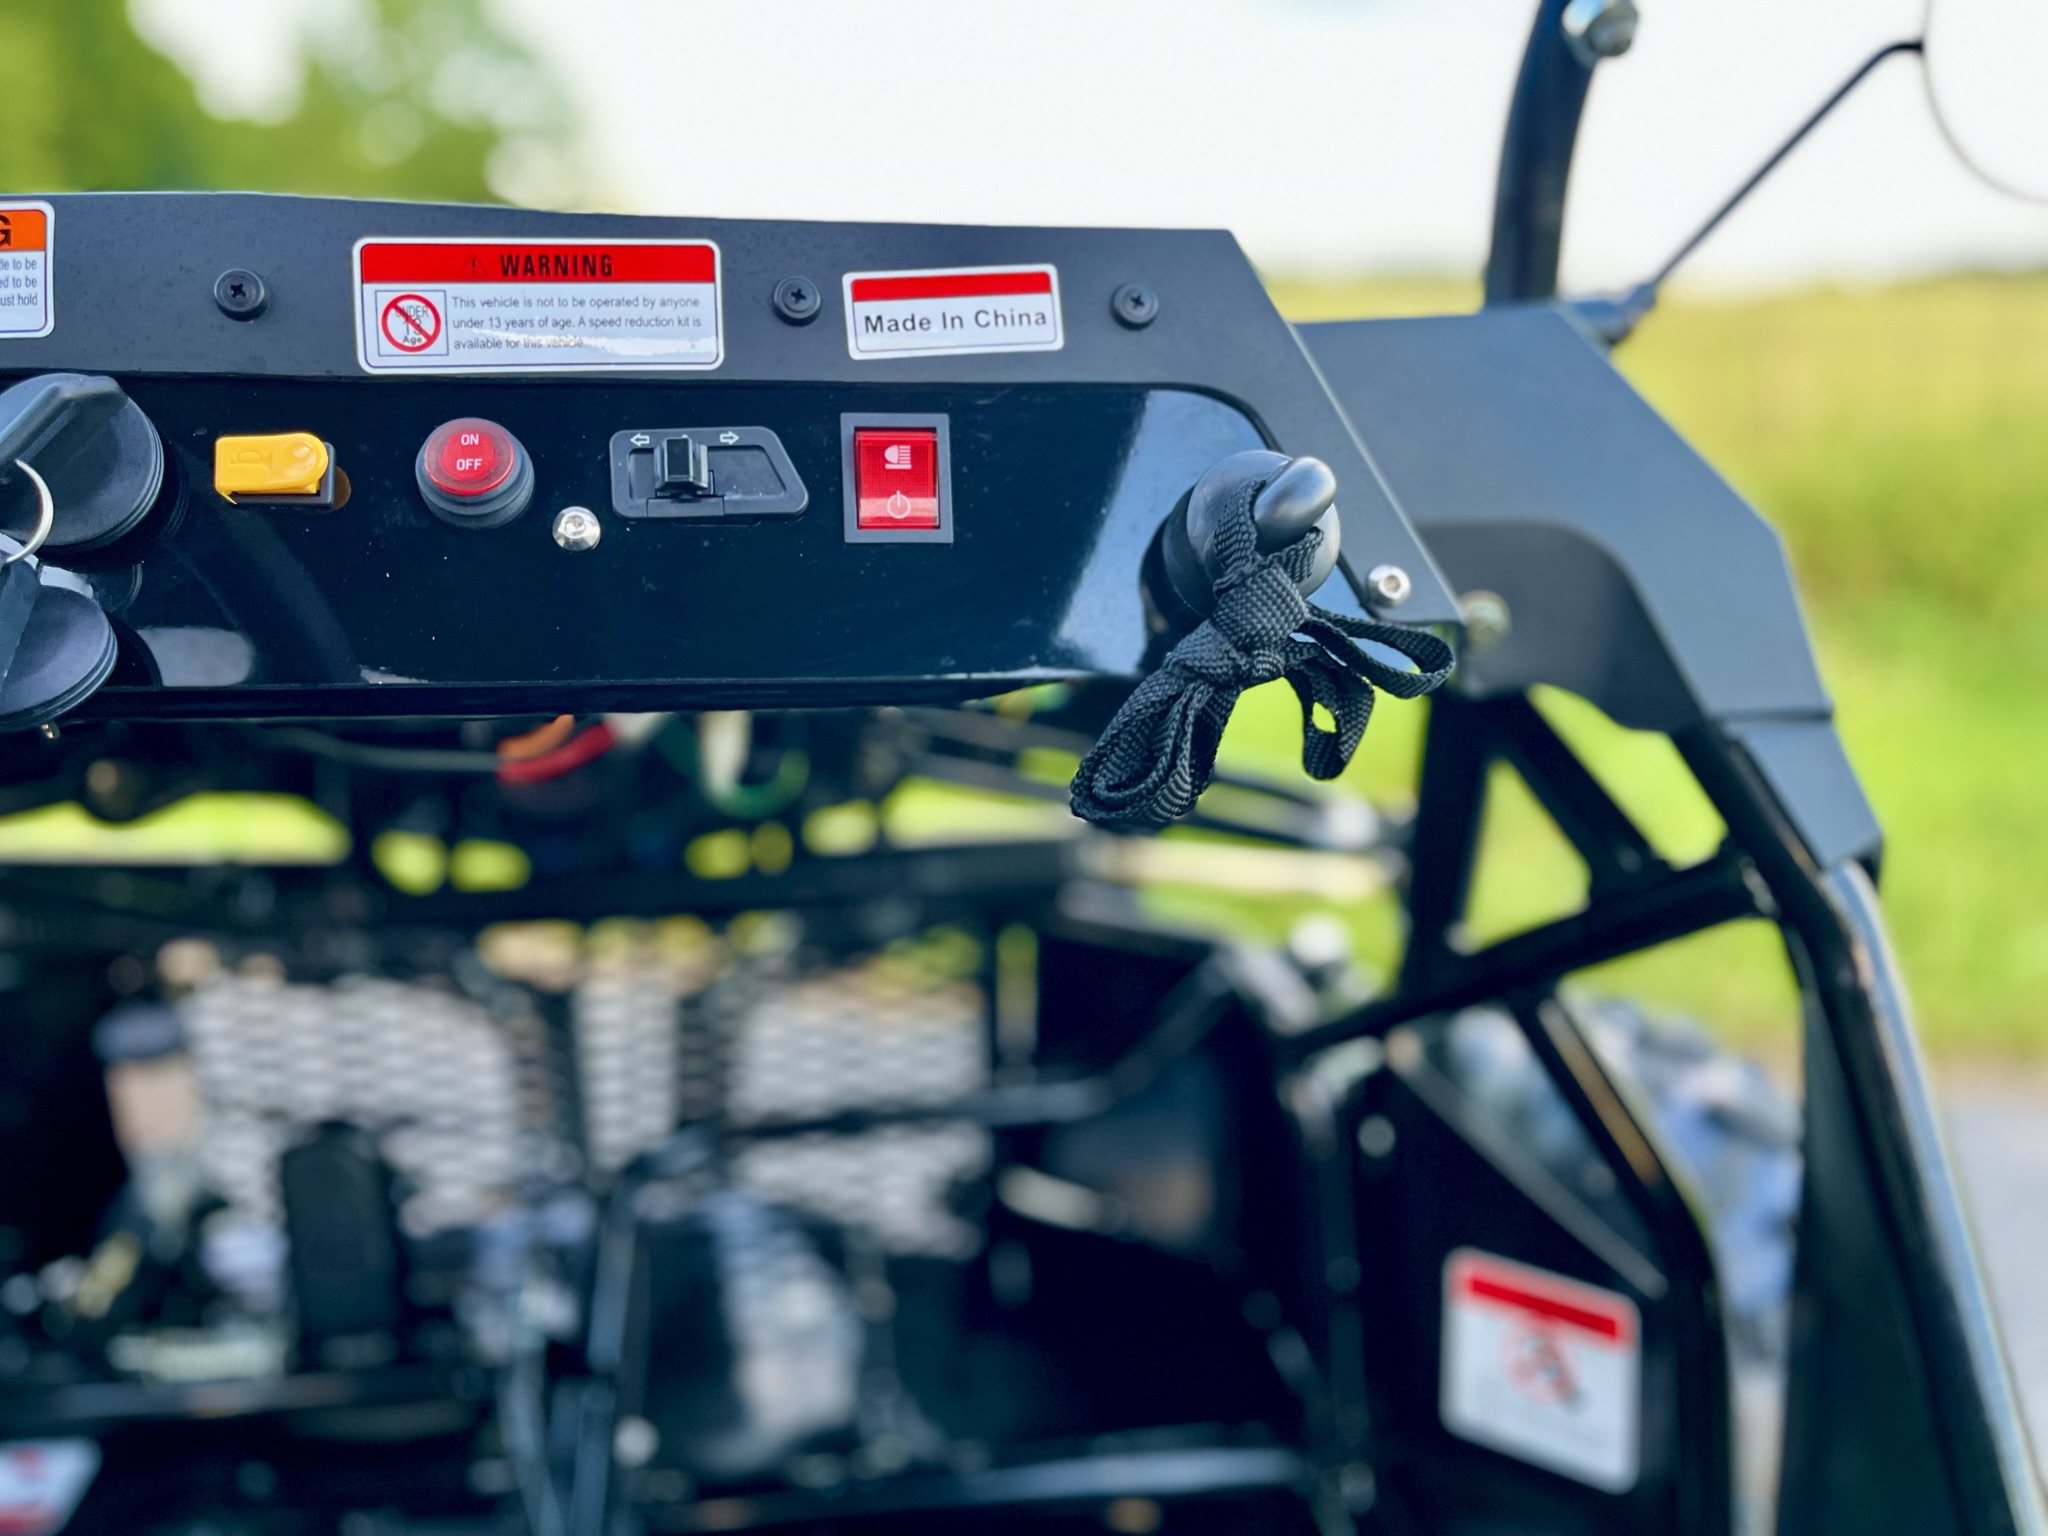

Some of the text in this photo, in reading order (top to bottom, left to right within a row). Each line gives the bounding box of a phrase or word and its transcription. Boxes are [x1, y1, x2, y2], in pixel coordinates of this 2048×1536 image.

[13, 259, 22, 270] to
[25, 257, 37, 270] be
[500, 254, 613, 276] WARNING
[13, 276, 21, 288] to
[25, 275, 37, 288] be
[18, 292, 38, 306] hold
[452, 296, 700, 310] This vehicle is not to be operated by anyone
[403, 317, 422, 336] 13
[453, 316, 702, 331] under 13 years of age. A speed reduction kit is
[864, 309, 1047, 334] Made In China
[403, 335, 423, 345] Age
[454, 338, 503, 350] available
[506, 338, 520, 349] for
[523, 337, 543, 348] this
[461, 434, 479, 445] ON
[456, 458, 483, 471] OFF
